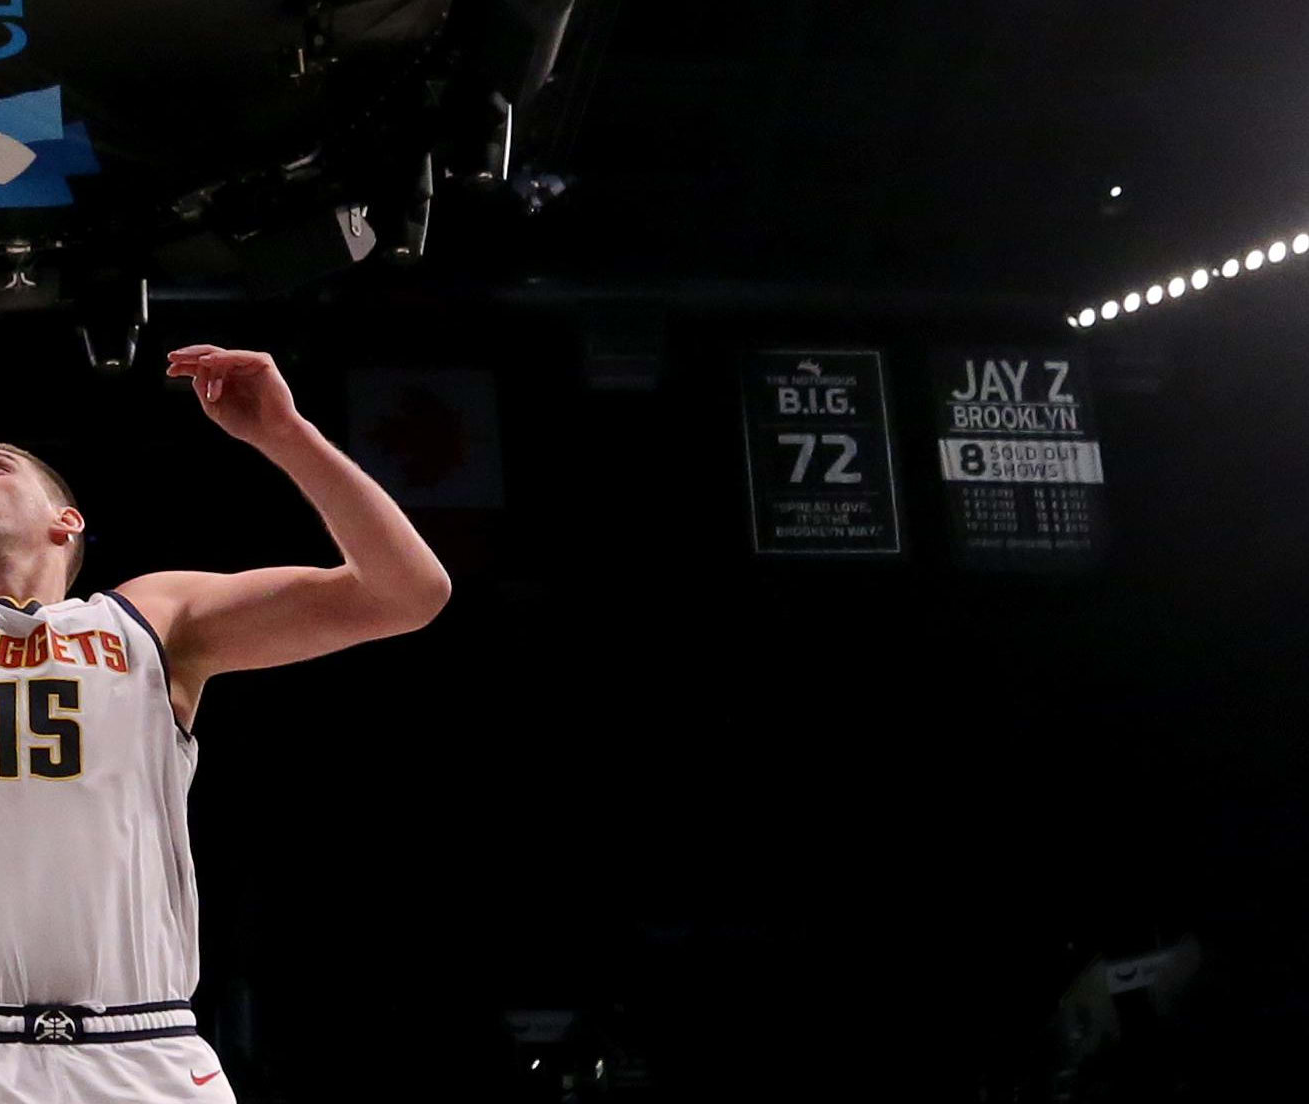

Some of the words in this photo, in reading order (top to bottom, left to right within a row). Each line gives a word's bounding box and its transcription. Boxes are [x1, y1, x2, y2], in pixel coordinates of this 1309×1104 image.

[951, 360, 1028, 401] JAY
[1043, 361, 1074, 401] Z
[779, 387, 856, 415] B.I.G.
[954, 405, 1076, 430] BROOKLYN
[778, 434, 862, 484] 72
[960, 443, 984, 476] 8
[991, 446, 1037, 461] SOLD
[1043, 446, 1079, 461] OUT
[992, 463, 1058, 478] SHOWS
